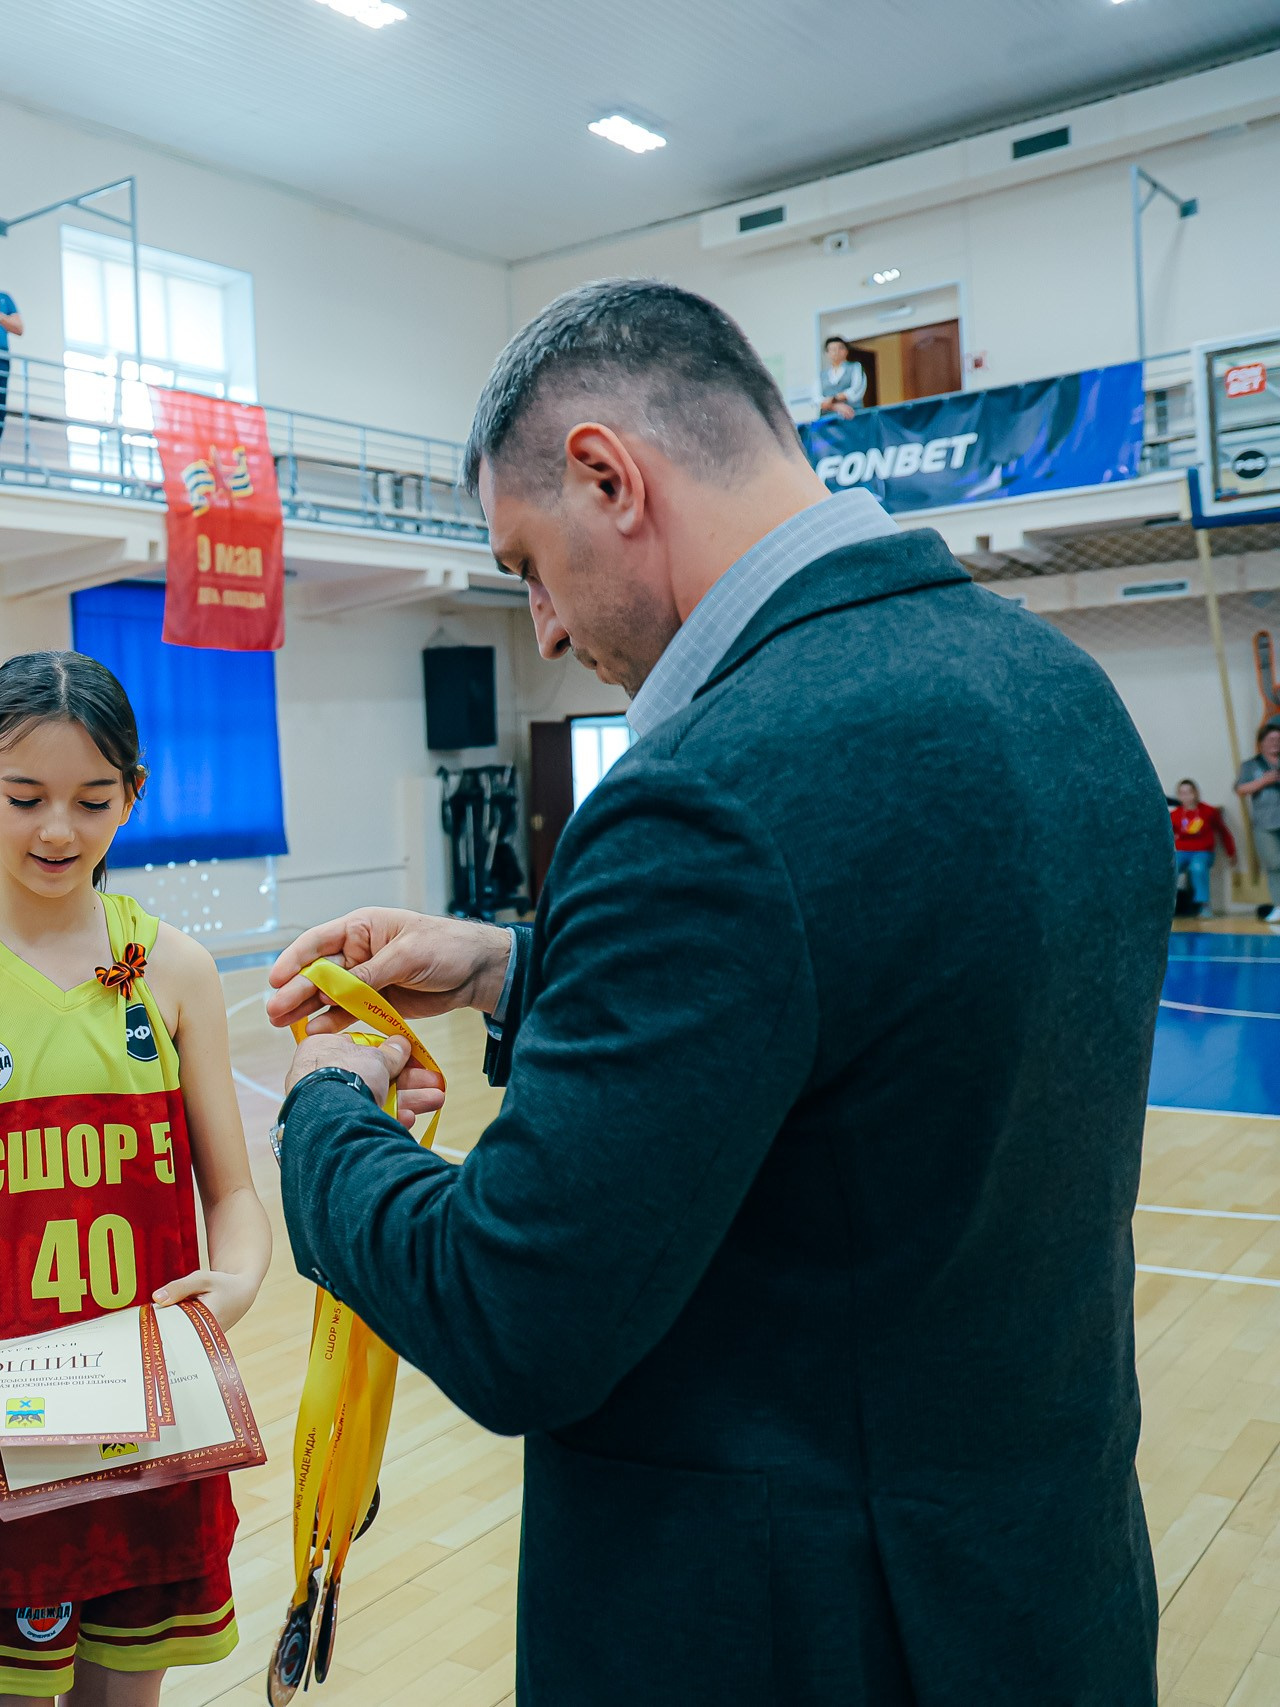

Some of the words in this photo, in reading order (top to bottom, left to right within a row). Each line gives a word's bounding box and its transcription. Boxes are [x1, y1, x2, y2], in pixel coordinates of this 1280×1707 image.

[816, 432, 978, 486] FONBET
[126, 1024, 151, 1042] РФ
[150, 1122, 176, 1185] 5
[31, 1213, 137, 1314] 40
[324, 1326, 338, 1361] СШОР
[300, 1427, 317, 1492] «НАДЕЖДА»
